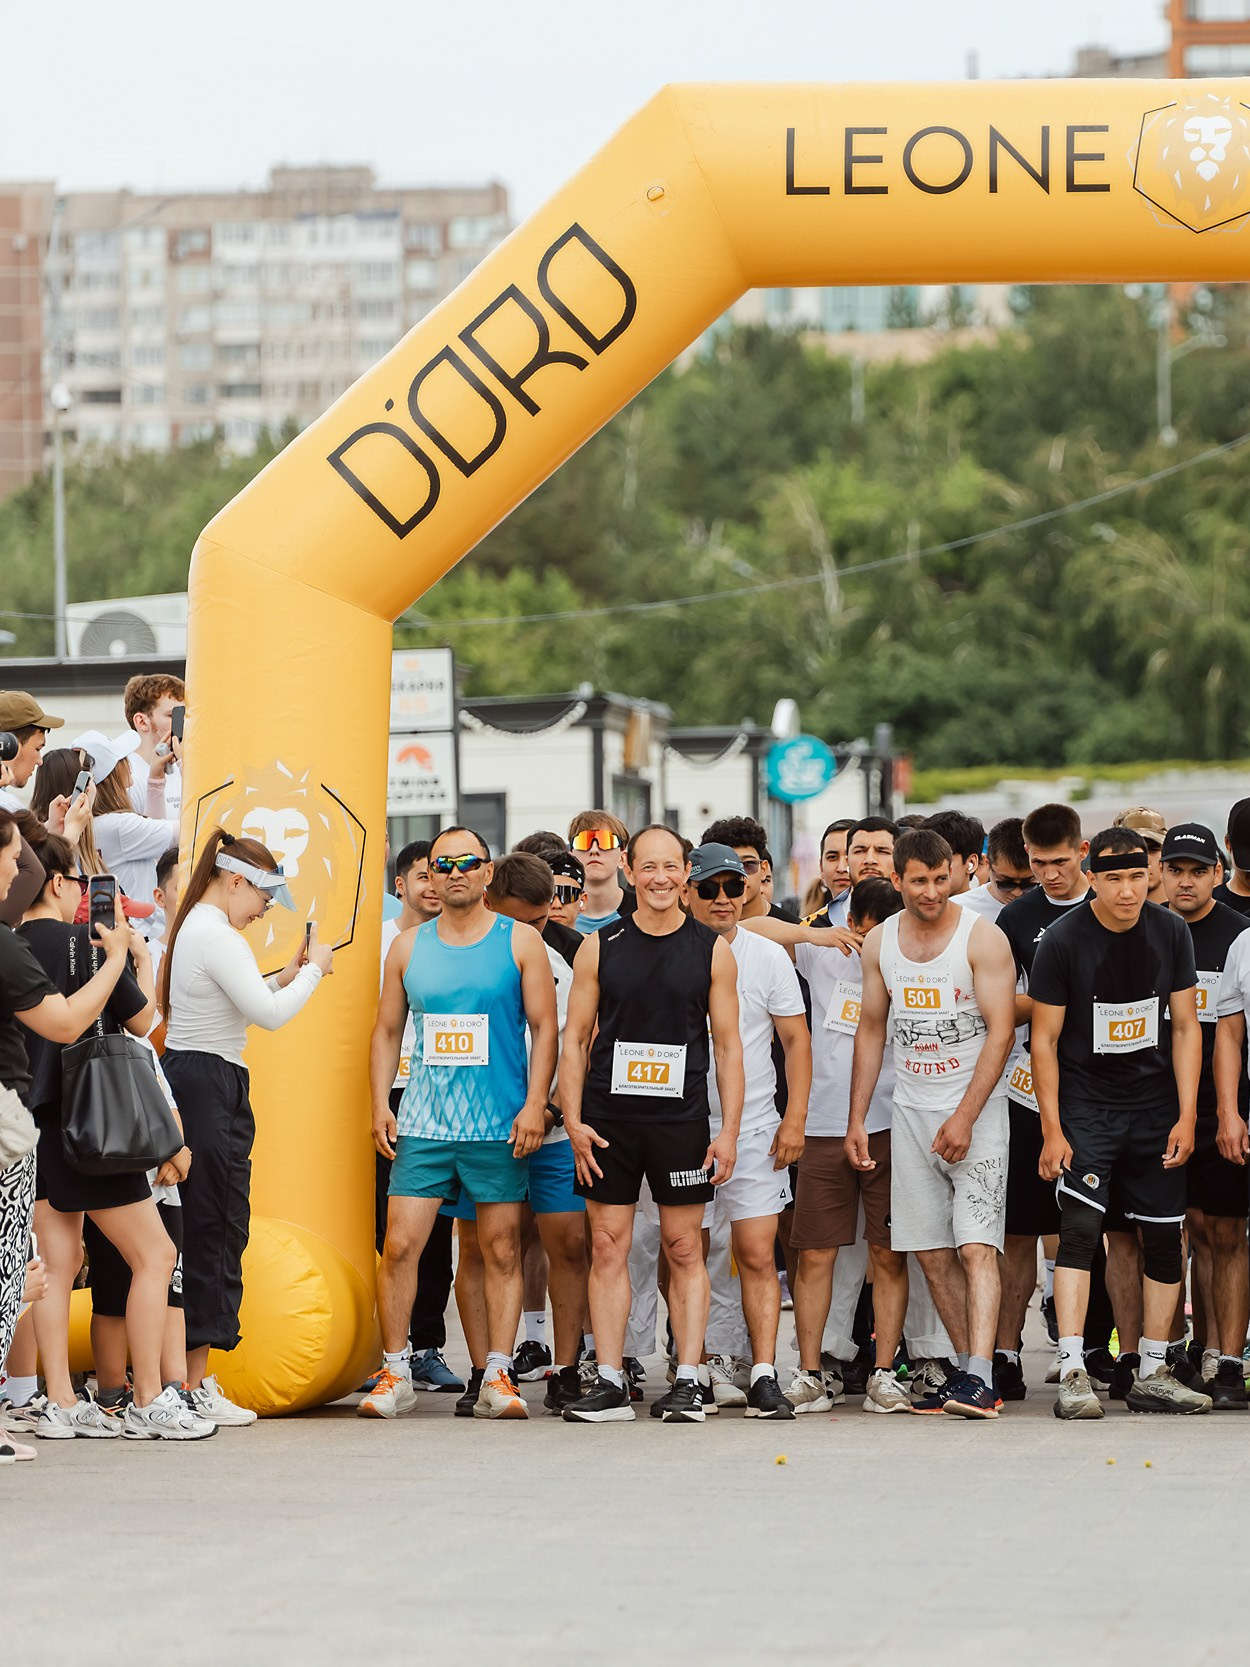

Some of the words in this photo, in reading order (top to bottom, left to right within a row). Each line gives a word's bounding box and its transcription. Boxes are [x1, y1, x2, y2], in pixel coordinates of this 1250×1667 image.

[785, 125, 1110, 195] LEONE
[326, 222, 637, 540] D'ORO
[896, 975, 916, 983] LEONE
[907, 990, 936, 1007] 501
[1099, 1009, 1125, 1017] LEONE
[1112, 1020, 1143, 1039] 407
[437, 1034, 469, 1052] 410
[619, 1048, 645, 1057] LEONE
[630, 1063, 666, 1081] 417
[1011, 1069, 1033, 1091] 313
